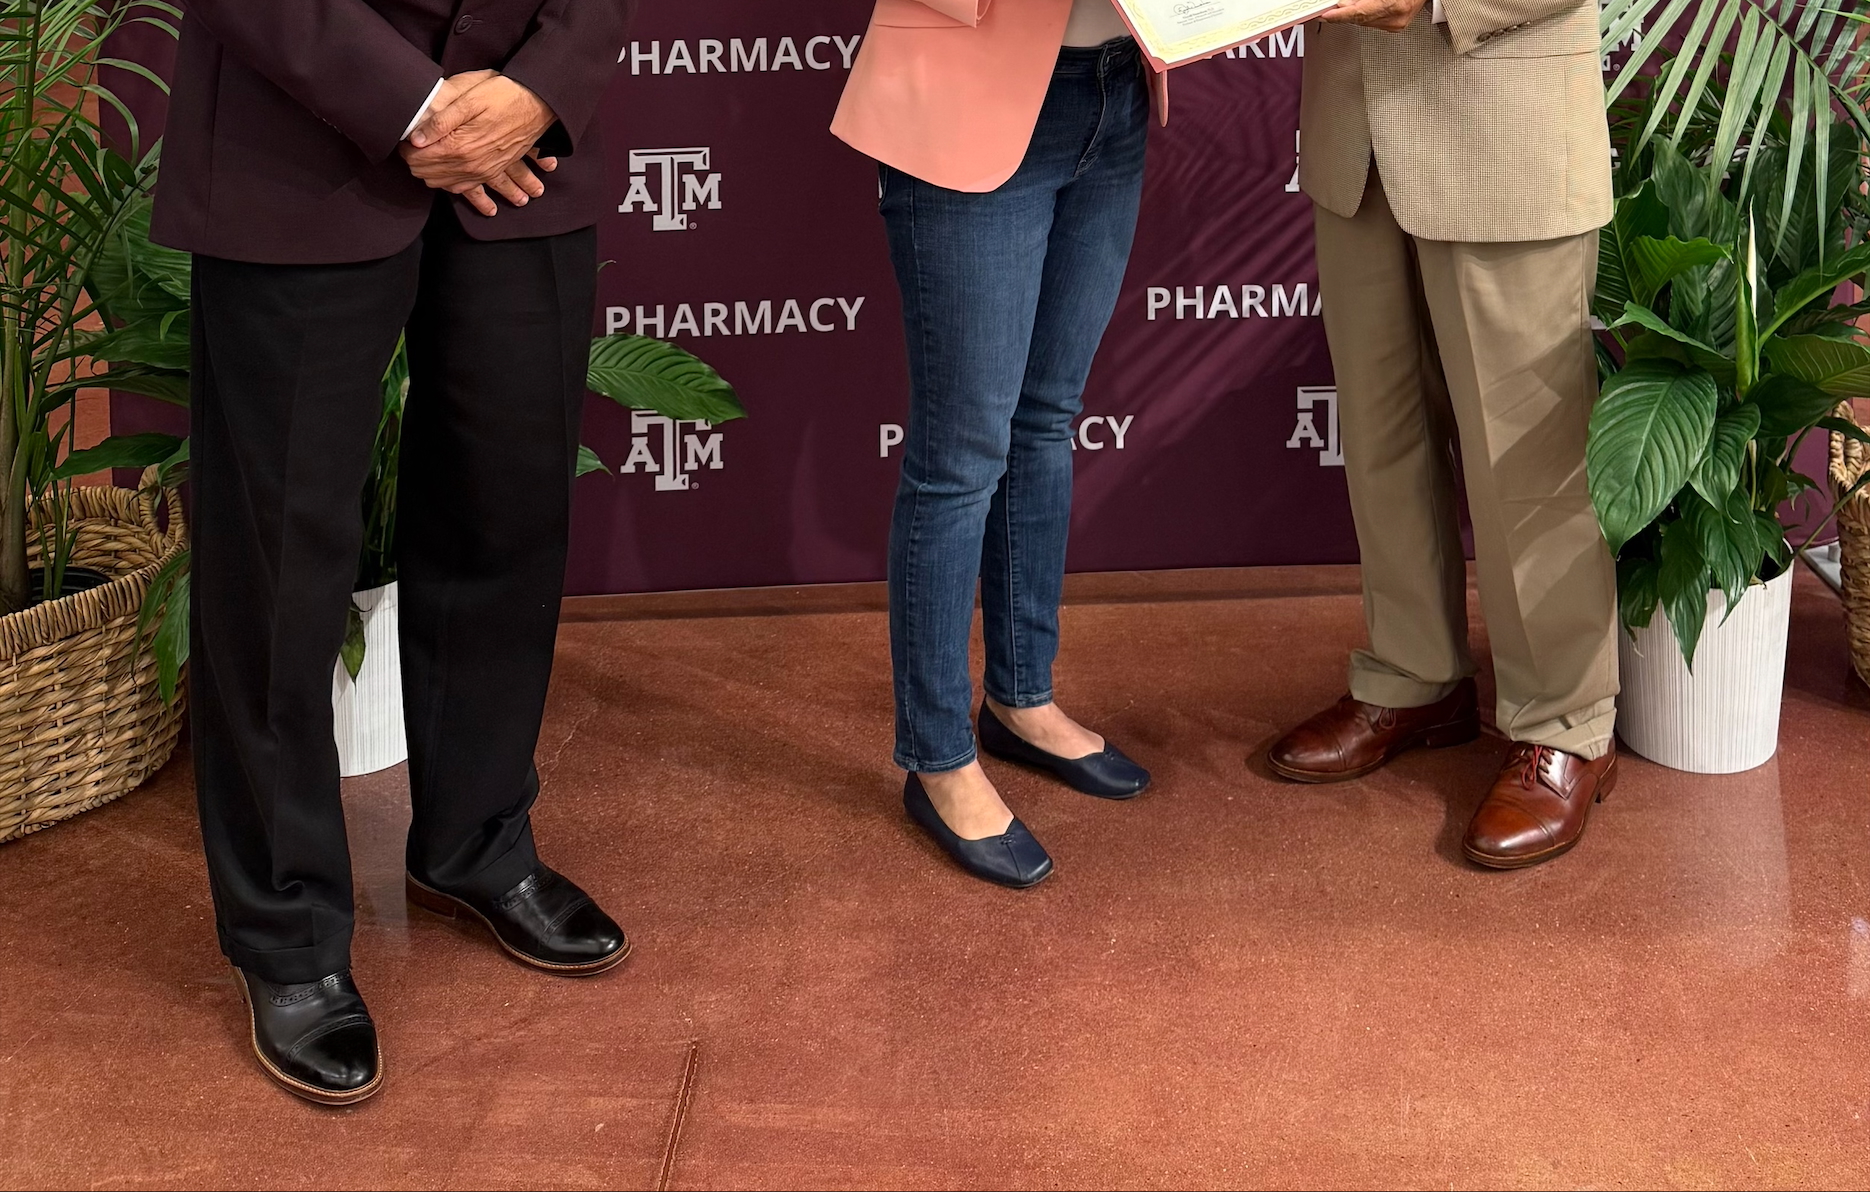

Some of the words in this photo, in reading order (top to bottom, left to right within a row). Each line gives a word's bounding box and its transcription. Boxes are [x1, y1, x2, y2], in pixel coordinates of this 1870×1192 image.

[617, 35, 861, 76] HARMACY
[606, 296, 865, 338] PHARMACY
[1147, 283, 1322, 321] PHARM
